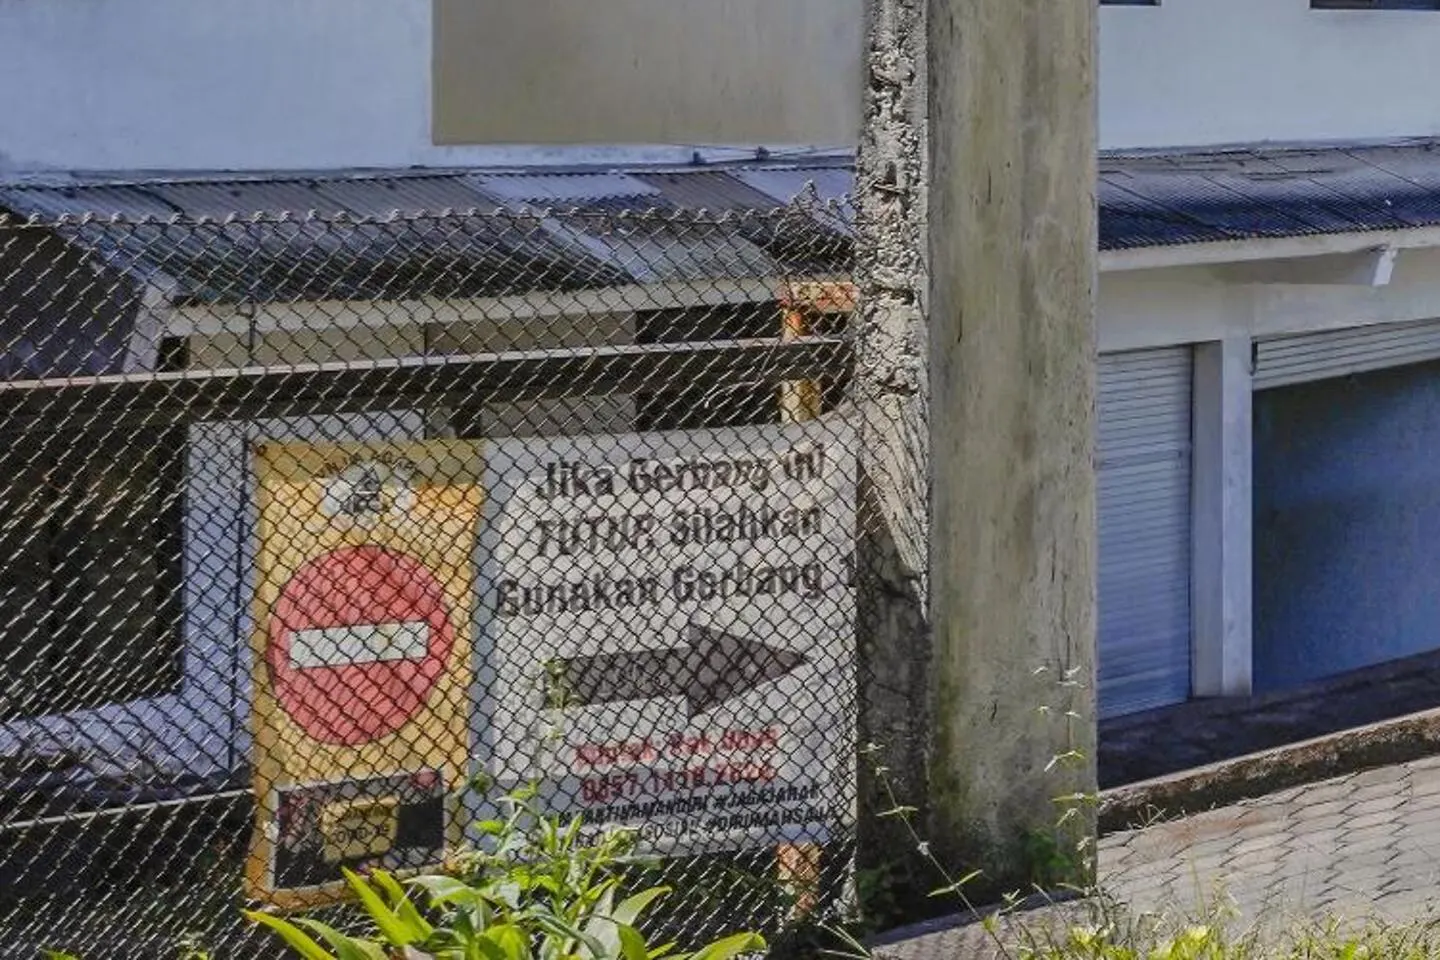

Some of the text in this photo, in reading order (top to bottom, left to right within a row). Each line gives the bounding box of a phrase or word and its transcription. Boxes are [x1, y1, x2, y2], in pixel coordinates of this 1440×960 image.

[536, 459, 614, 500] Jika
[628, 455, 770, 494] Gerbang
[496, 568, 660, 618] Gunakan
[672, 561, 822, 602] Gerbang
